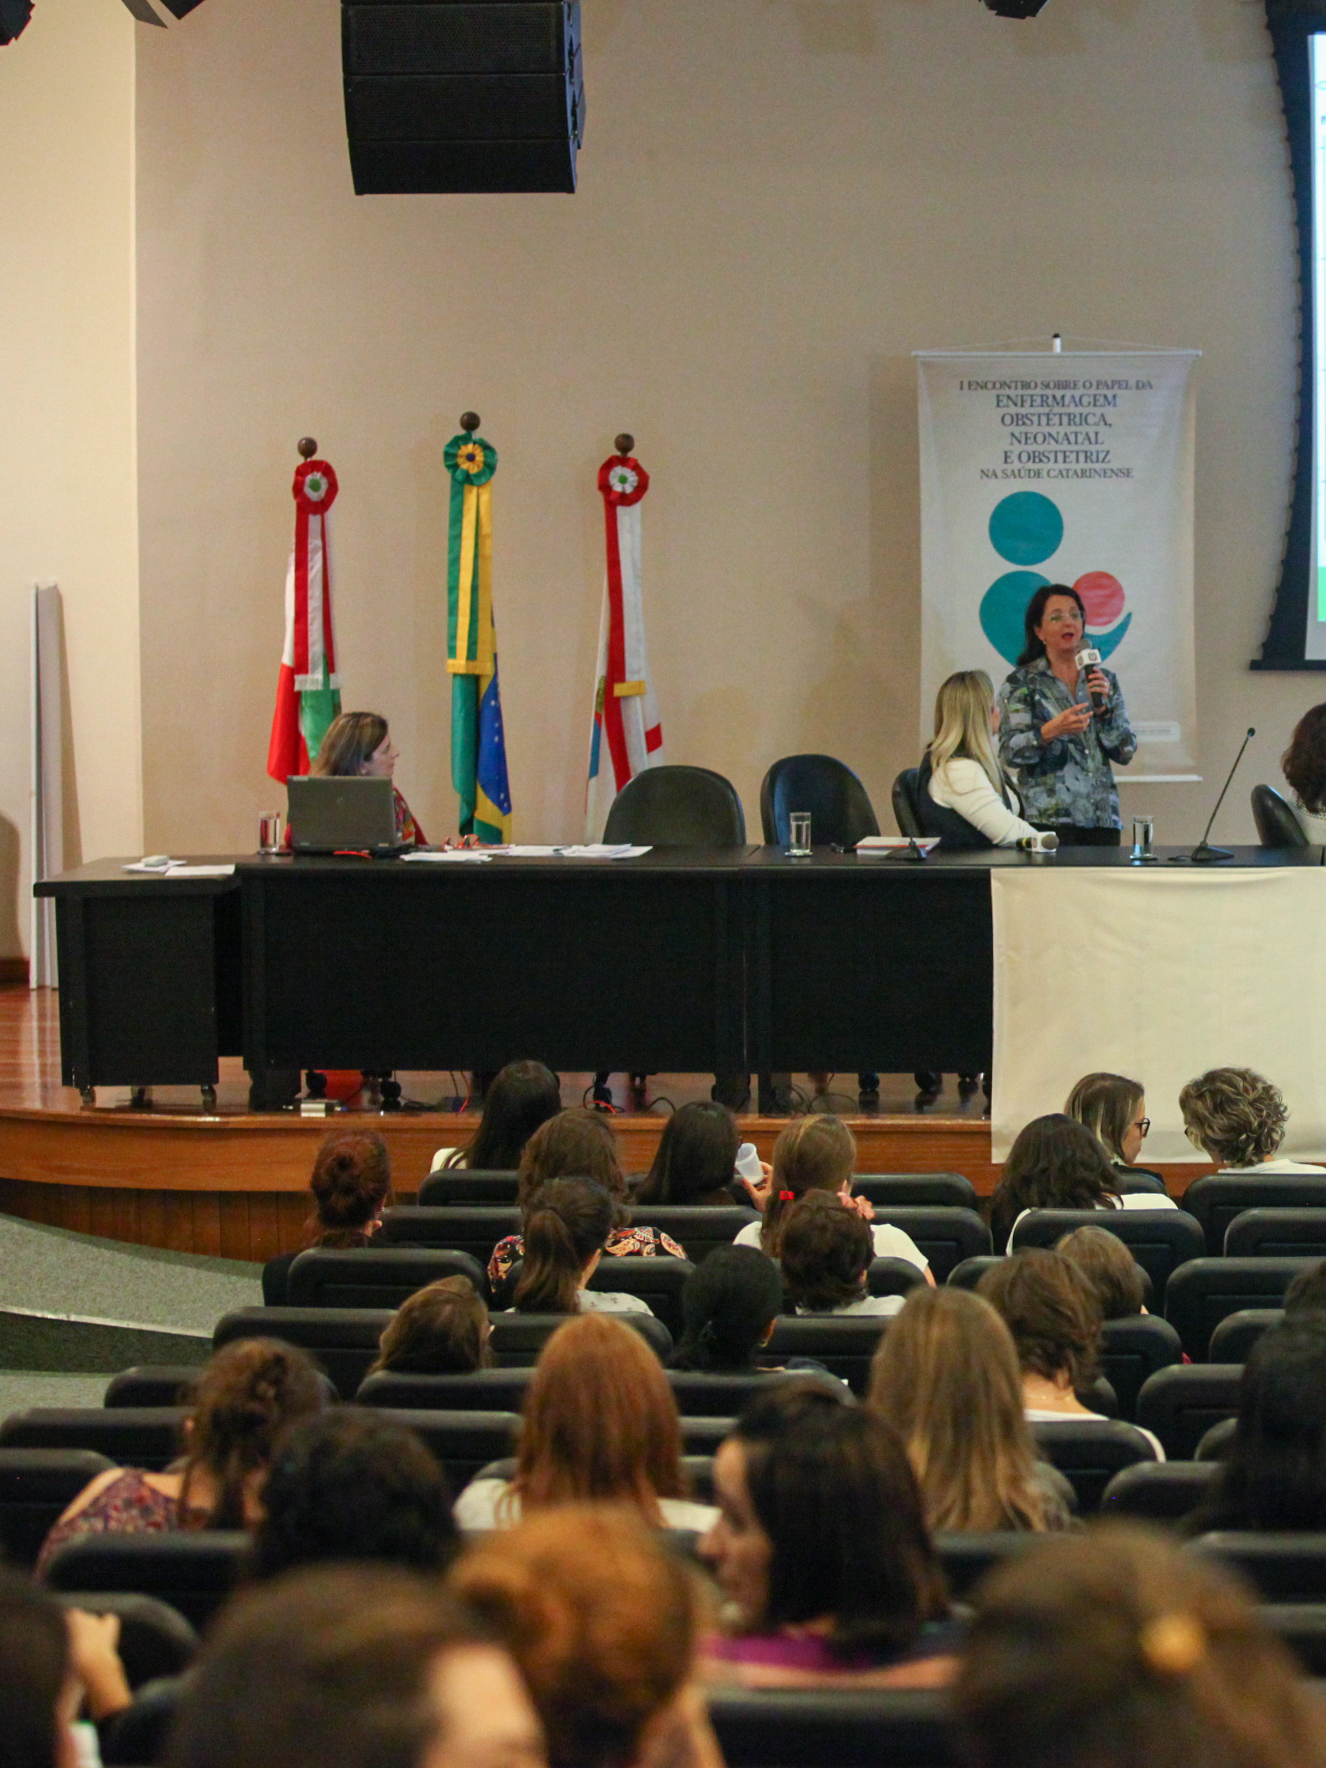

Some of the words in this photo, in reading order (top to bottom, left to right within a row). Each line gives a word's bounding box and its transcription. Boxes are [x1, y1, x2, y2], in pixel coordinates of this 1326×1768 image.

[958, 380, 965, 391] I
[967, 380, 1038, 391] ENCONTRO
[1040, 379, 1079, 391] SOBRE
[1082, 380, 1093, 391] O
[1095, 379, 1132, 391] PAPEL
[1135, 380, 1154, 391] DA
[995, 394, 1118, 409] ENFERMAGEM
[1000, 409, 1113, 428] OBSTÉTRICA,
[1009, 431, 1105, 446] NEONATAL
[1003, 450, 1014, 465] E
[1017, 450, 1111, 465] OBSTETRIZ
[979, 468, 999, 480] NA
[1001, 465, 1045, 480] SAÚDE
[1047, 467, 1134, 480] CATARINENSE
